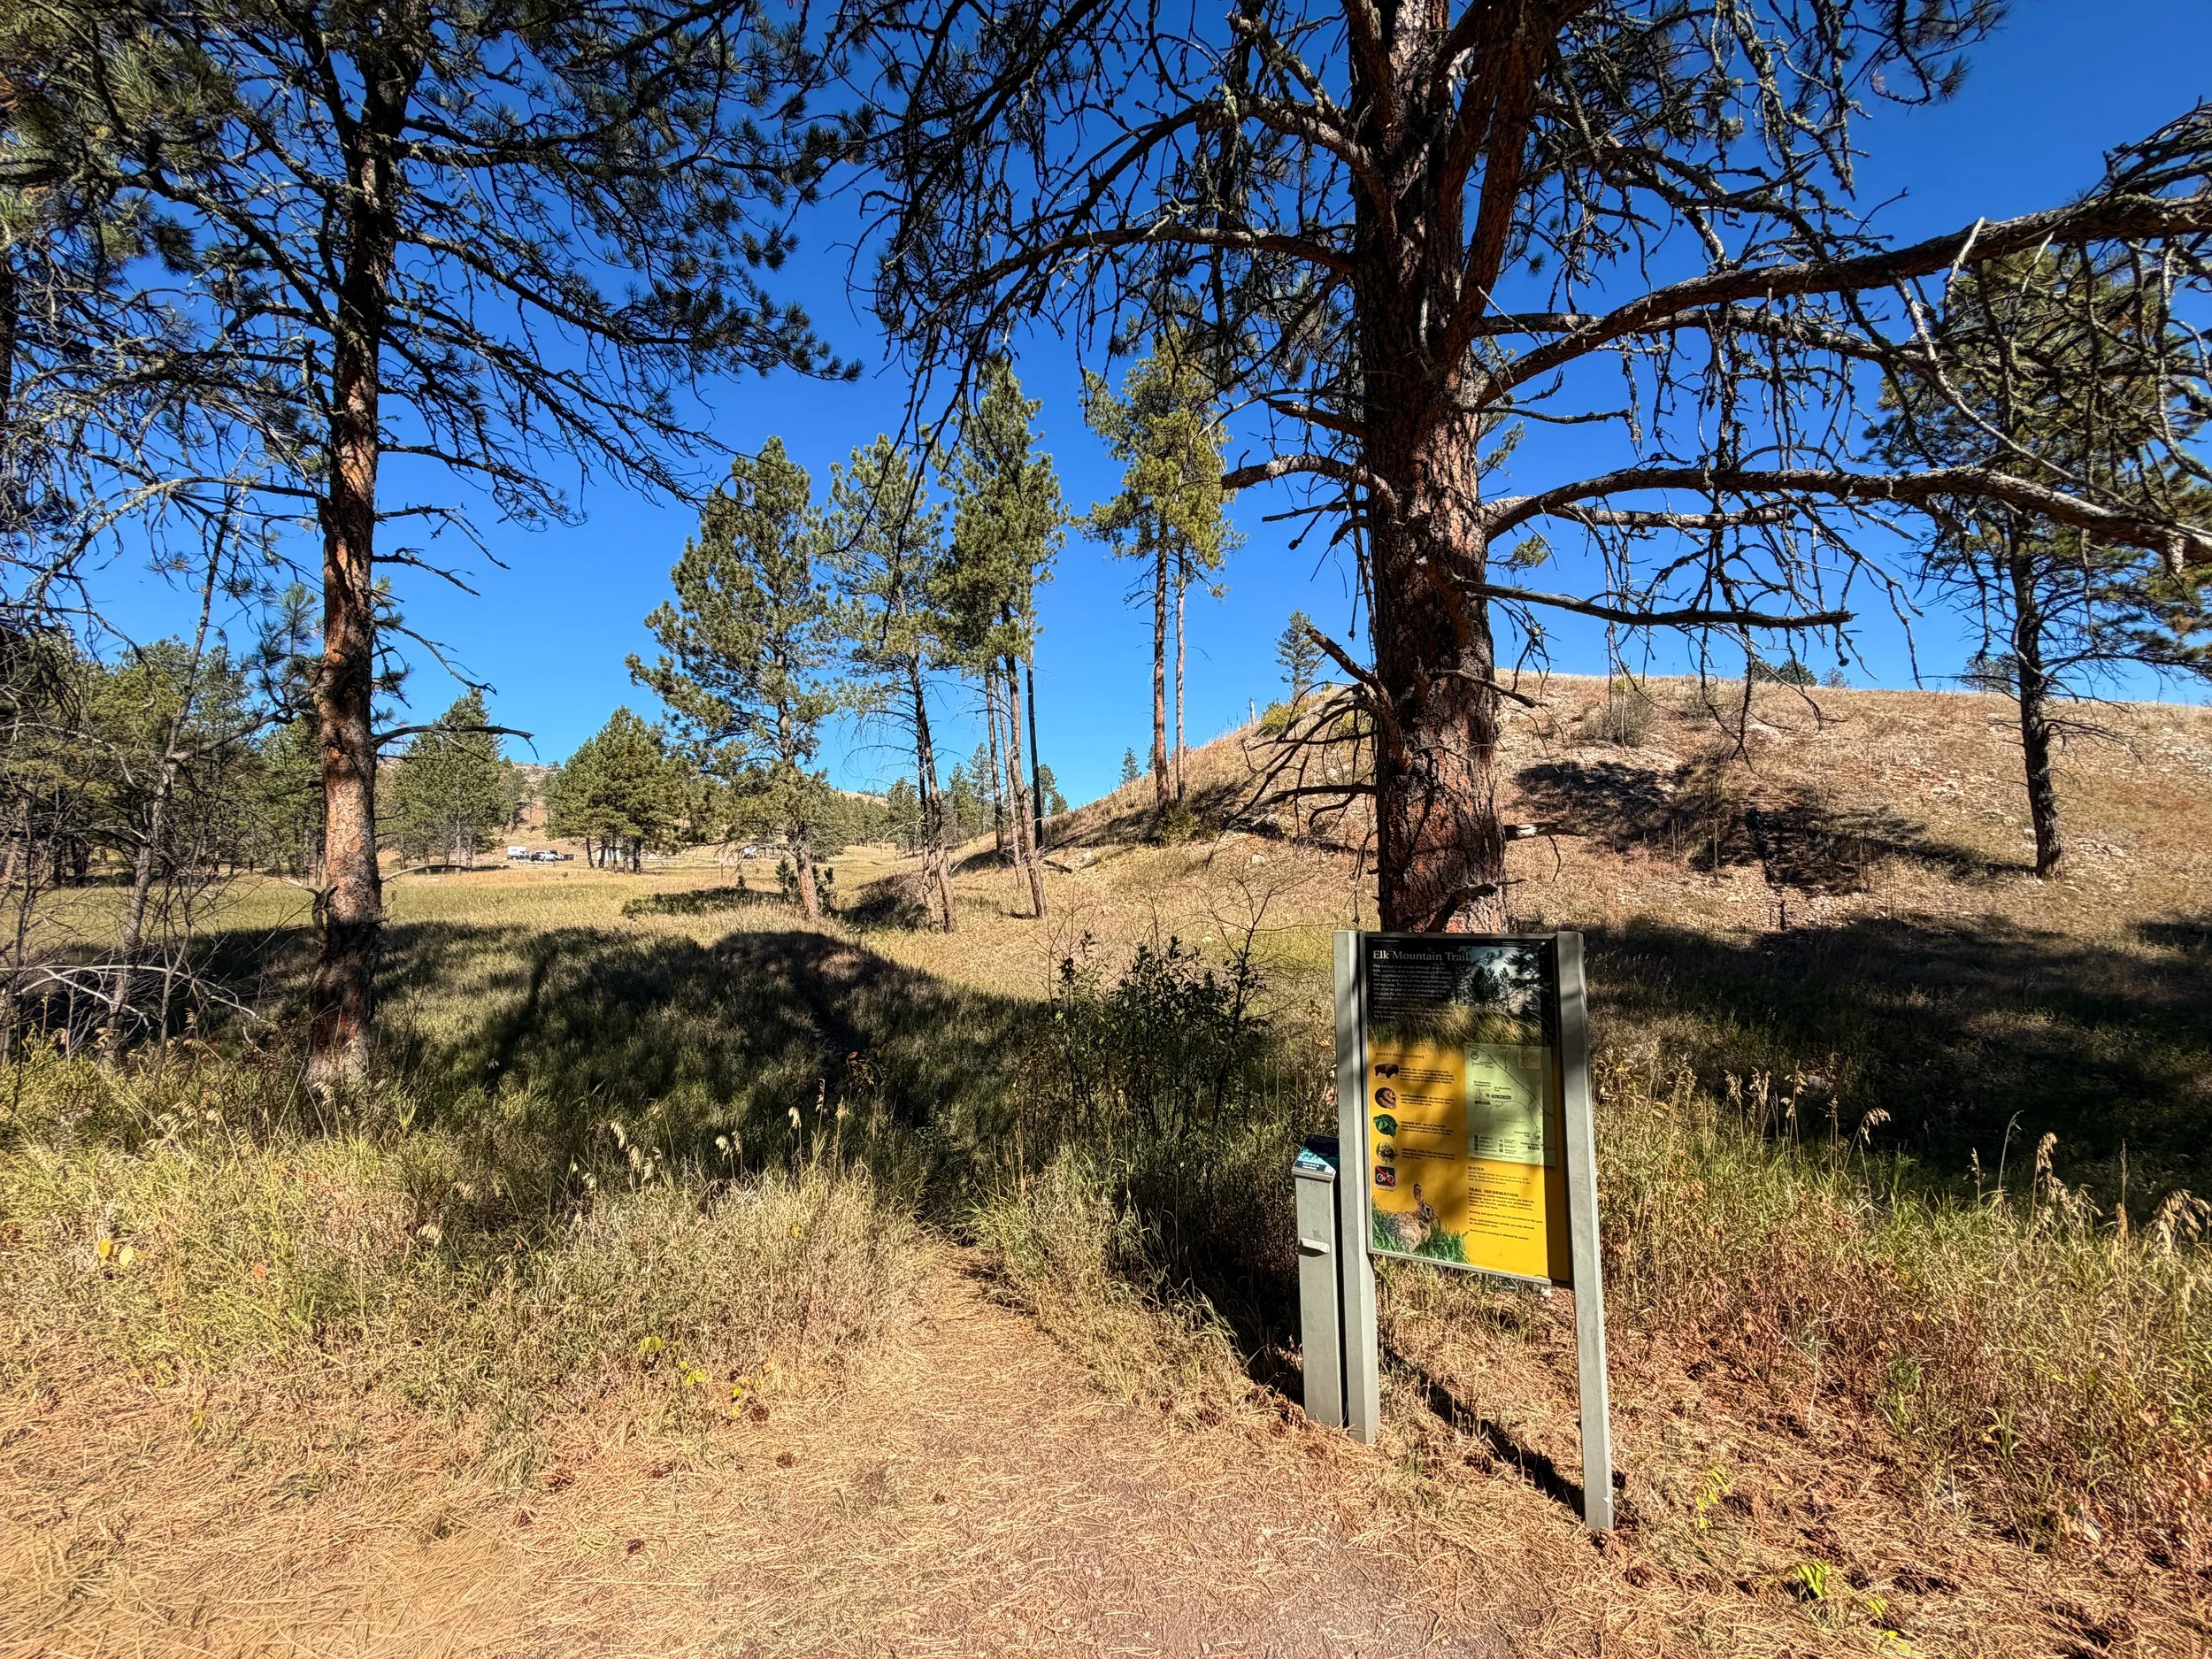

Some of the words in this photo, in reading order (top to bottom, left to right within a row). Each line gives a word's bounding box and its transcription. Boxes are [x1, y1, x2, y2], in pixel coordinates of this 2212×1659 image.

[1373, 949, 1390, 960] Elk
[1392, 950, 1442, 961] Mountain
[1444, 951, 1469, 962] Trail
